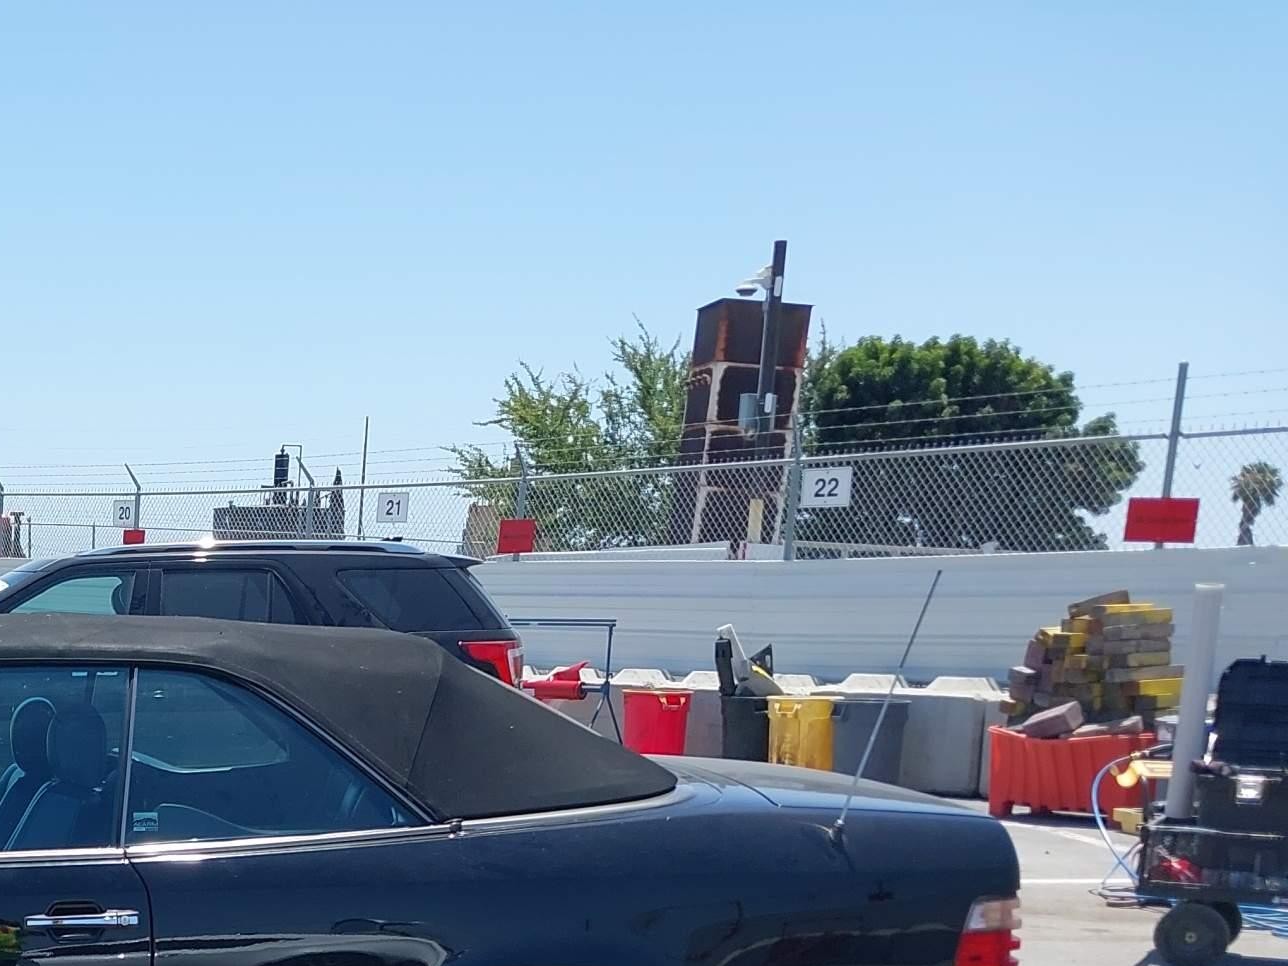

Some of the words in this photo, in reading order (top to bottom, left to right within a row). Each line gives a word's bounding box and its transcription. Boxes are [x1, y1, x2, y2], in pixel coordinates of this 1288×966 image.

[813, 477, 840, 498] 22
[118, 506, 131, 520] 20
[386, 499, 401, 516] 21
